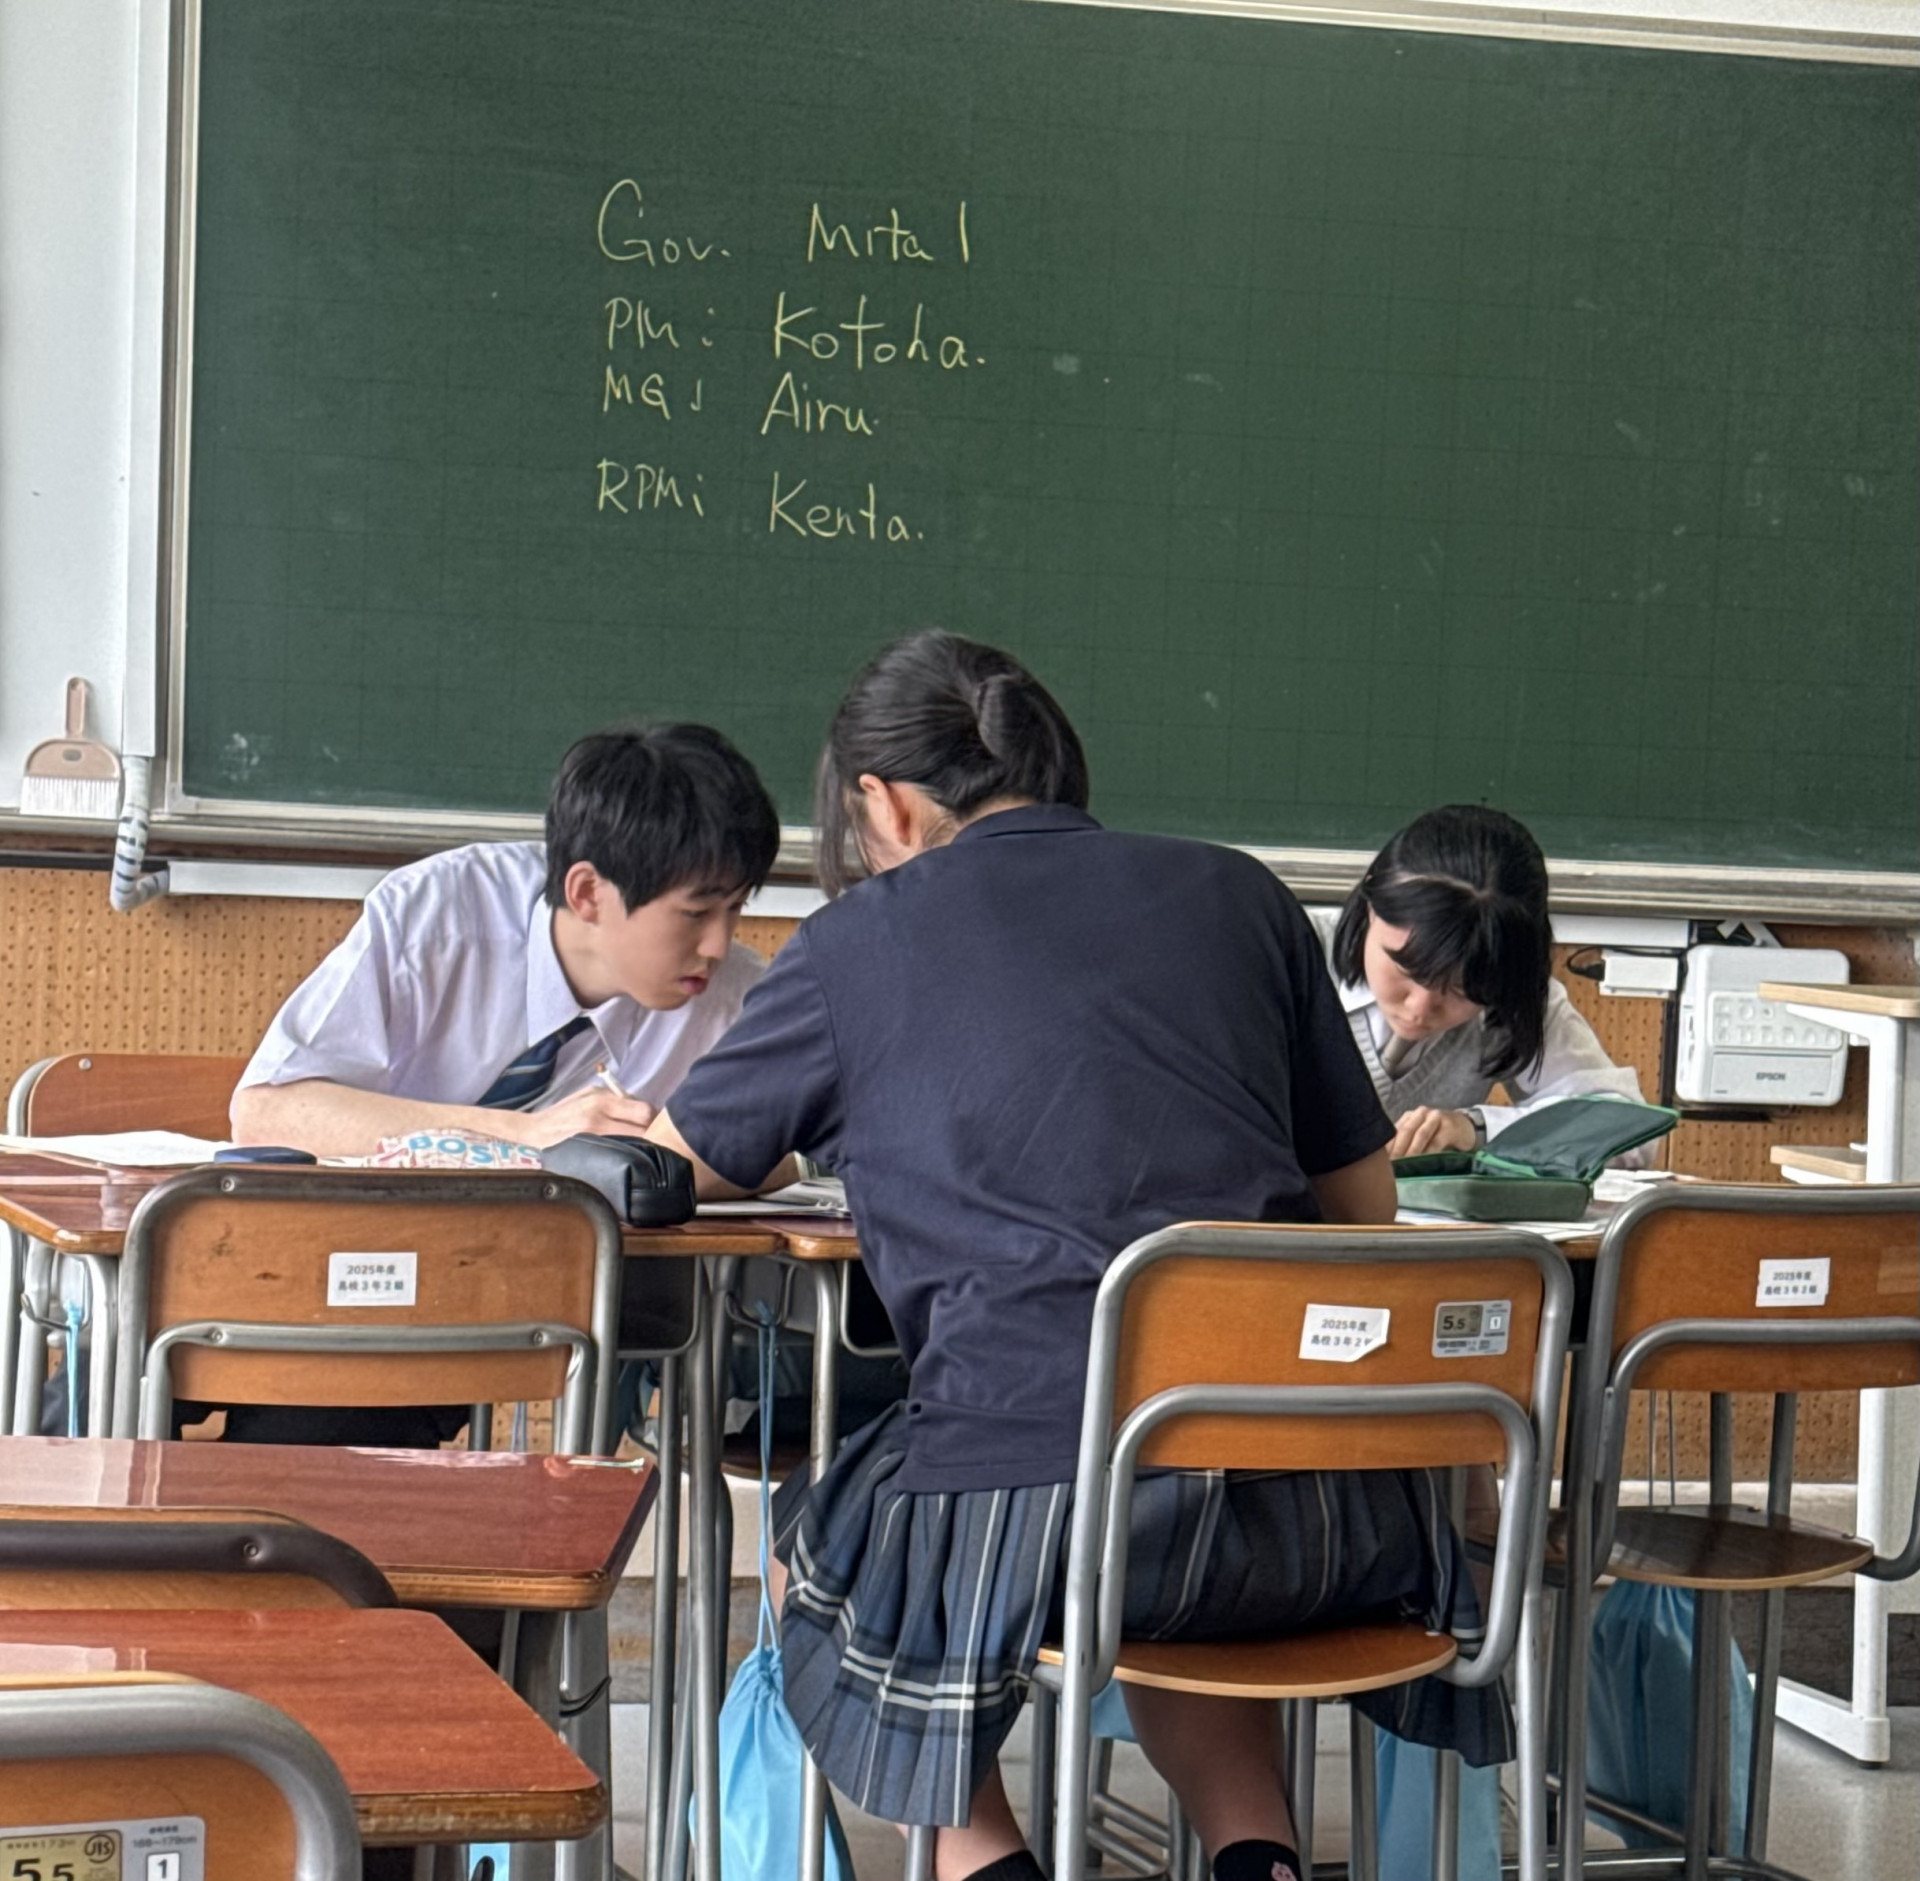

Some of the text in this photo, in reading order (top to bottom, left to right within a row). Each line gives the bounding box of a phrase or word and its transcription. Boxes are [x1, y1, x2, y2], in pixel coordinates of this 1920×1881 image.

[597, 178, 731, 267] Gov.
[773, 291, 986, 371] Kotoha.
[1756, 1071, 1786, 1081] EPSON
[346, 1264, 396, 1276] 2025年度
[157, 1858, 168, 1880] 1
